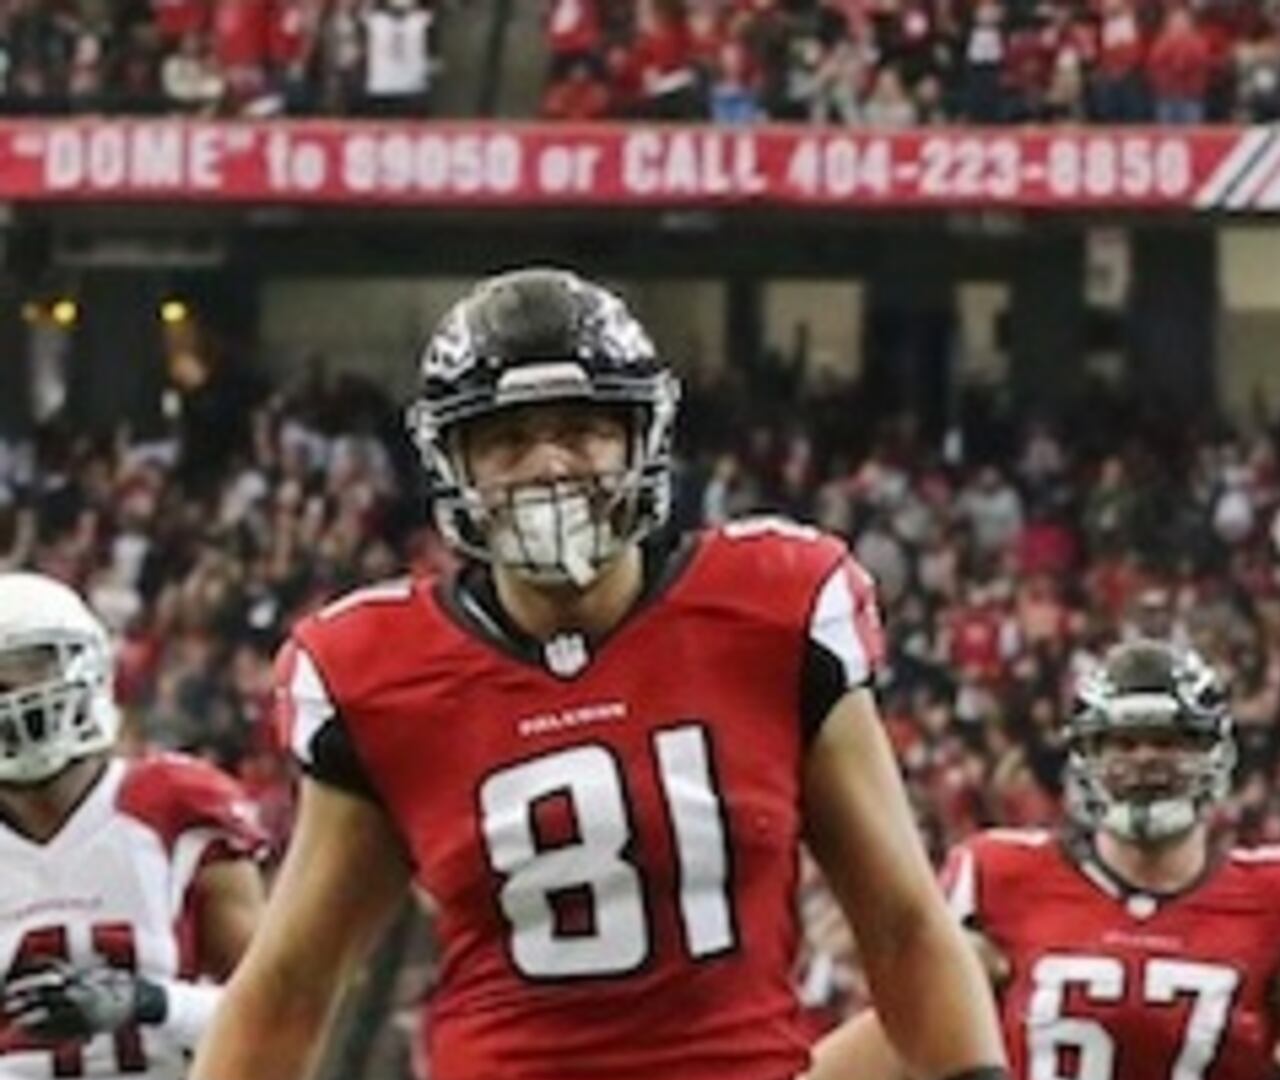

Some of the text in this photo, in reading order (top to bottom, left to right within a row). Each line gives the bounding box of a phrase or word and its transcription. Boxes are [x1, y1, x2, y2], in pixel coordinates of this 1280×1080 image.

[267, 133, 326, 191] to
[539, 146, 602, 191] or
[622, 134, 767, 194] CALL
[479, 724, 736, 980] 81
